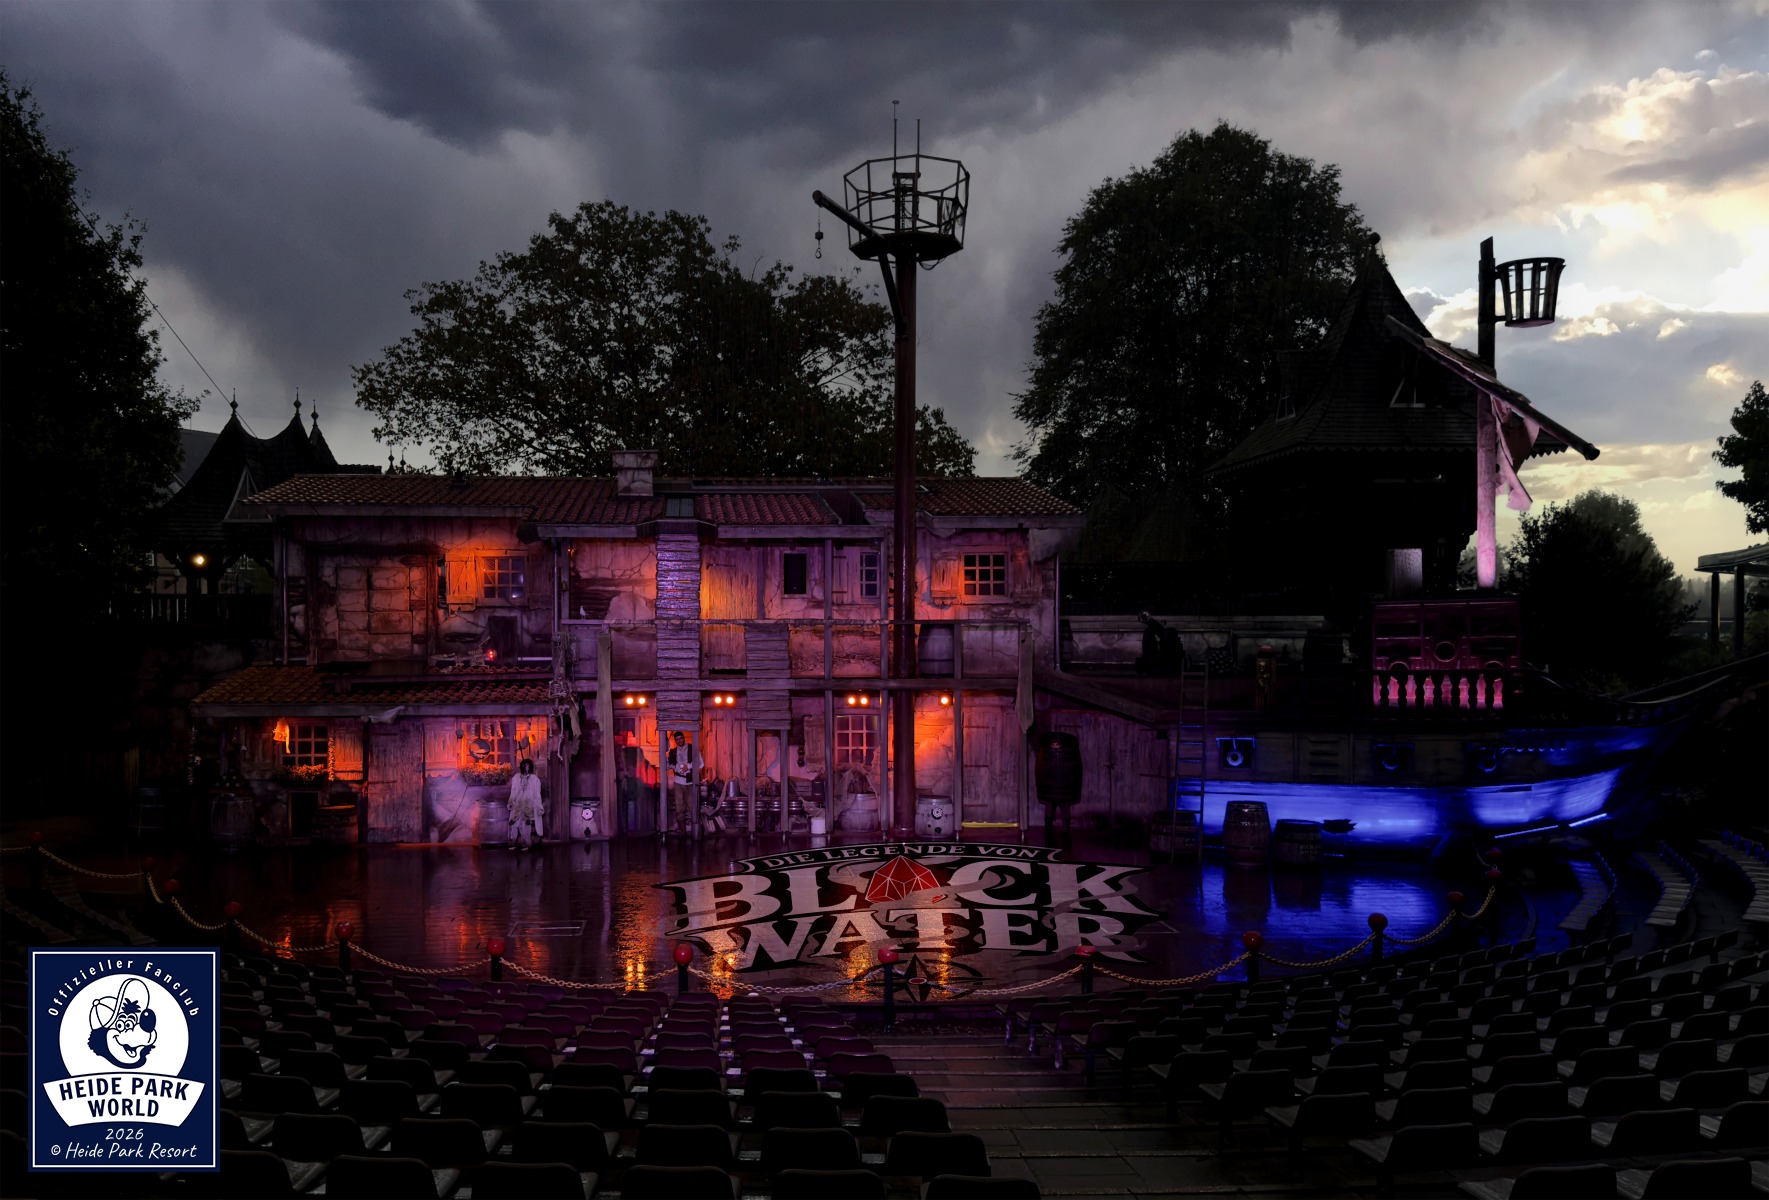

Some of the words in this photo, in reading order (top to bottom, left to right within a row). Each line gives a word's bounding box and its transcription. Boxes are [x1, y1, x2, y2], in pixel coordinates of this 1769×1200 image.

[764, 852, 811, 868] DIE
[831, 844, 966, 861] LEGENDE
[977, 846, 1039, 859] VON
[656, 860, 1161, 935] BLCK
[684, 907, 1149, 971] WATER
